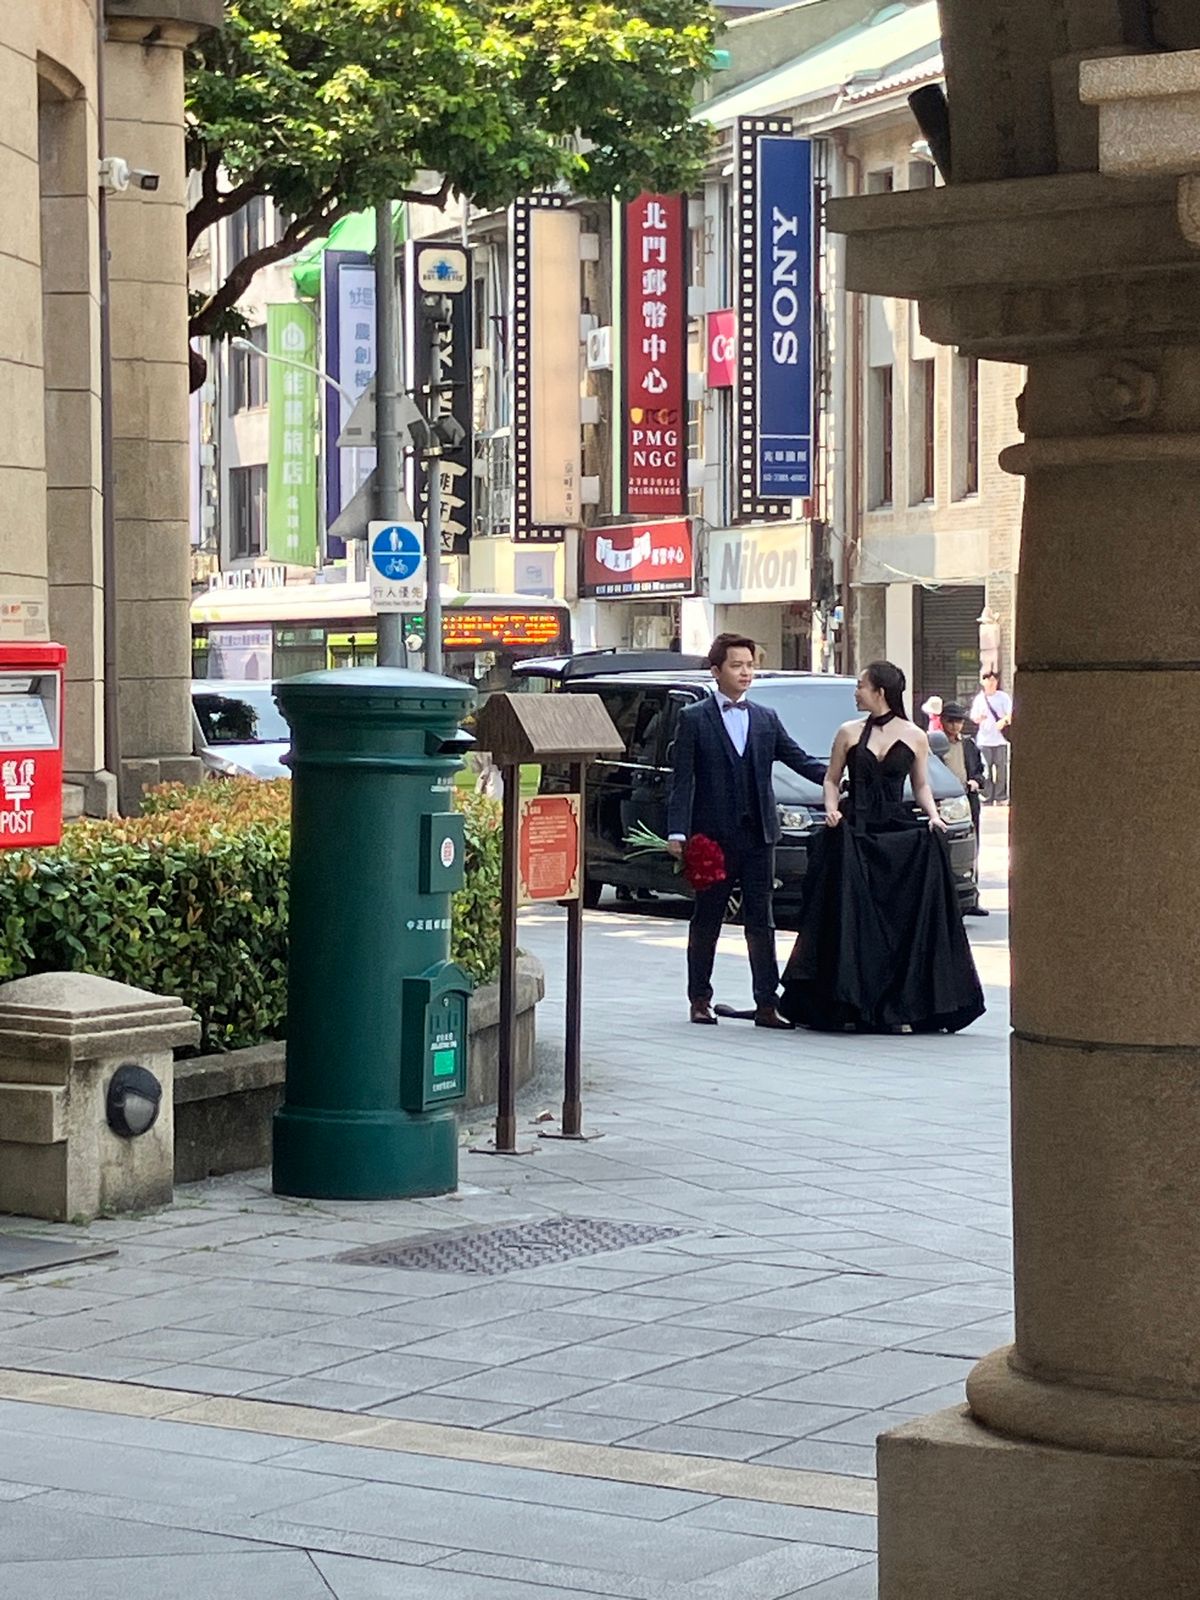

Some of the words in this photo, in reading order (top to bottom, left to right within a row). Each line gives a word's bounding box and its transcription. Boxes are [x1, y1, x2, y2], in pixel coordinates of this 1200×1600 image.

[642, 202, 668, 394] 北門郵幣中心
[772, 206, 798, 365] SONY
[632, 429, 678, 446] PMG
[633, 450, 677, 468] NGC
[720, 540, 798, 591] Nikon
[373, 586, 423, 598] 行人優先
[0, 808, 34, 834] POST
